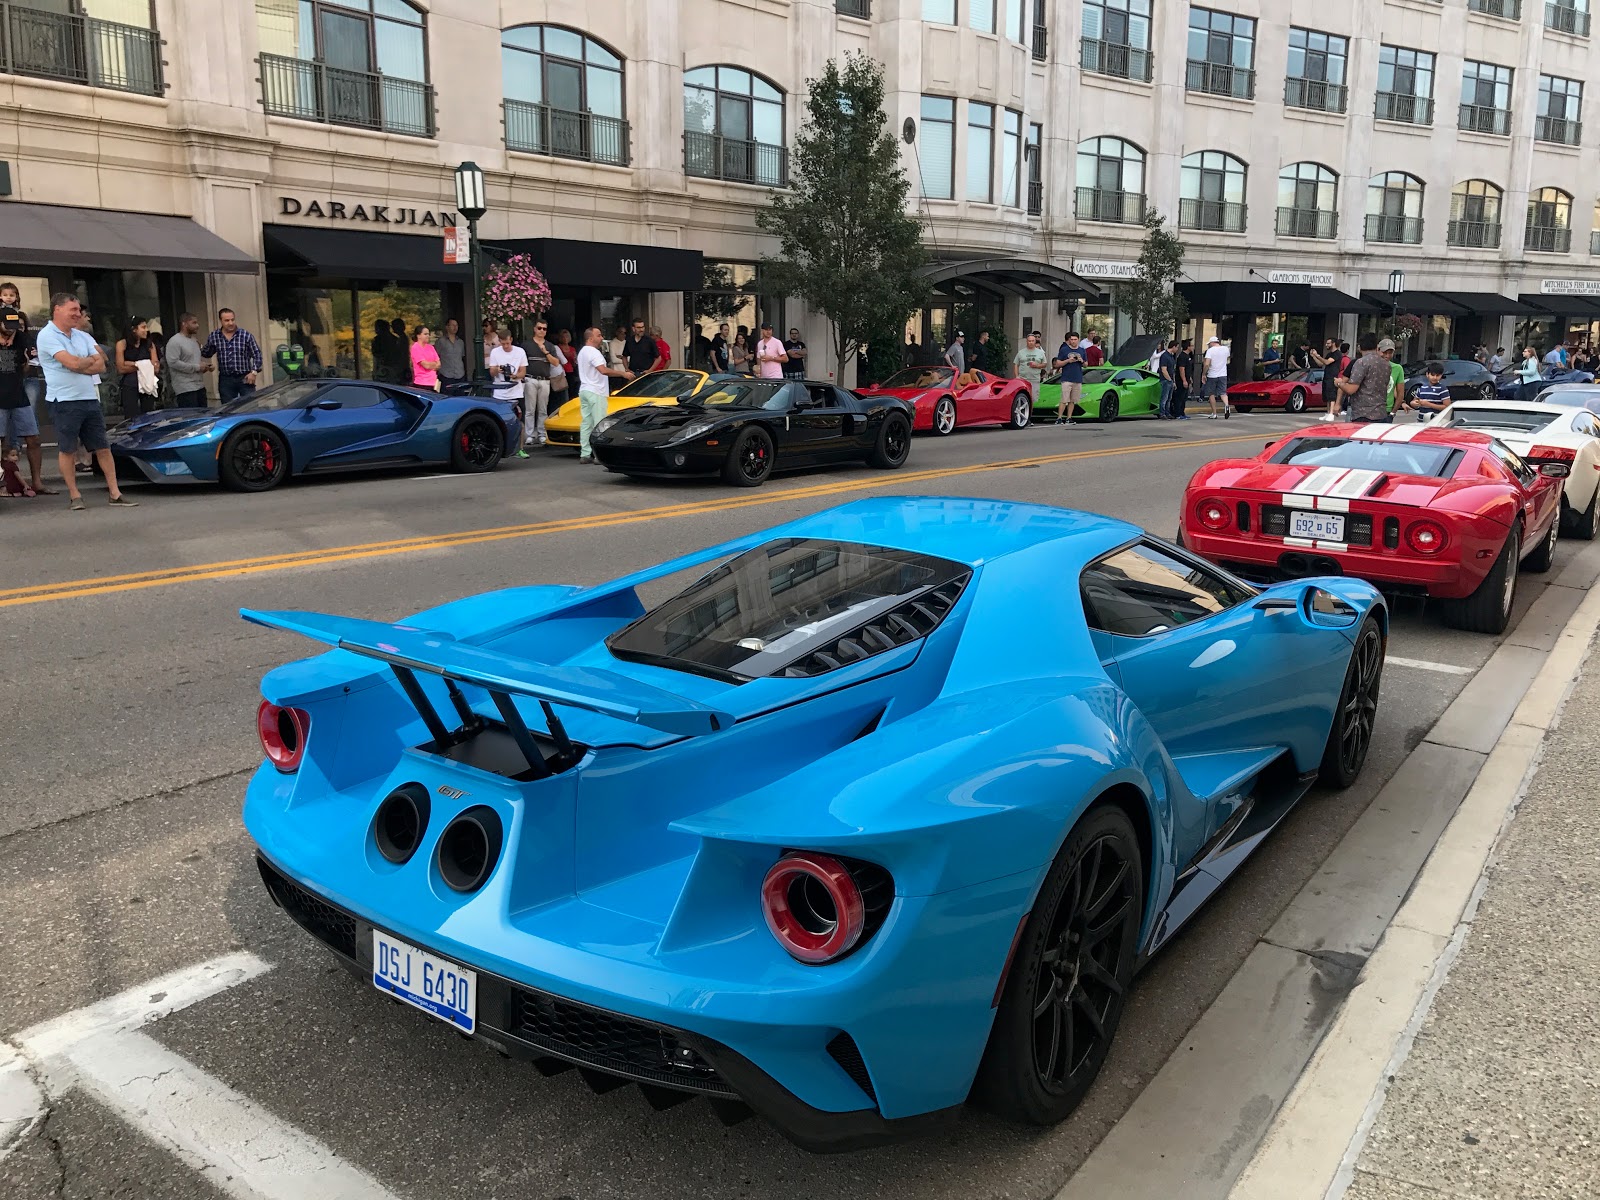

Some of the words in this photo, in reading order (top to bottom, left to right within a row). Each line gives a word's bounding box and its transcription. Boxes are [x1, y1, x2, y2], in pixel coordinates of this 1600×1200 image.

[279, 196, 458, 228] DARAKJIAN
[446, 238, 456, 251] IN
[620, 258, 638, 275] 101
[1302, 274, 1332, 285] STEAKHOUSE
[1574, 281, 1585, 289] FISH
[1262, 291, 1277, 304] 115
[1296, 519, 1314, 532] 692
[1325, 521, 1338, 535] 65
[379, 940, 411, 987] DSJ
[423, 961, 469, 1015] 6430
[407, 992, 439, 1013] michigan.org
